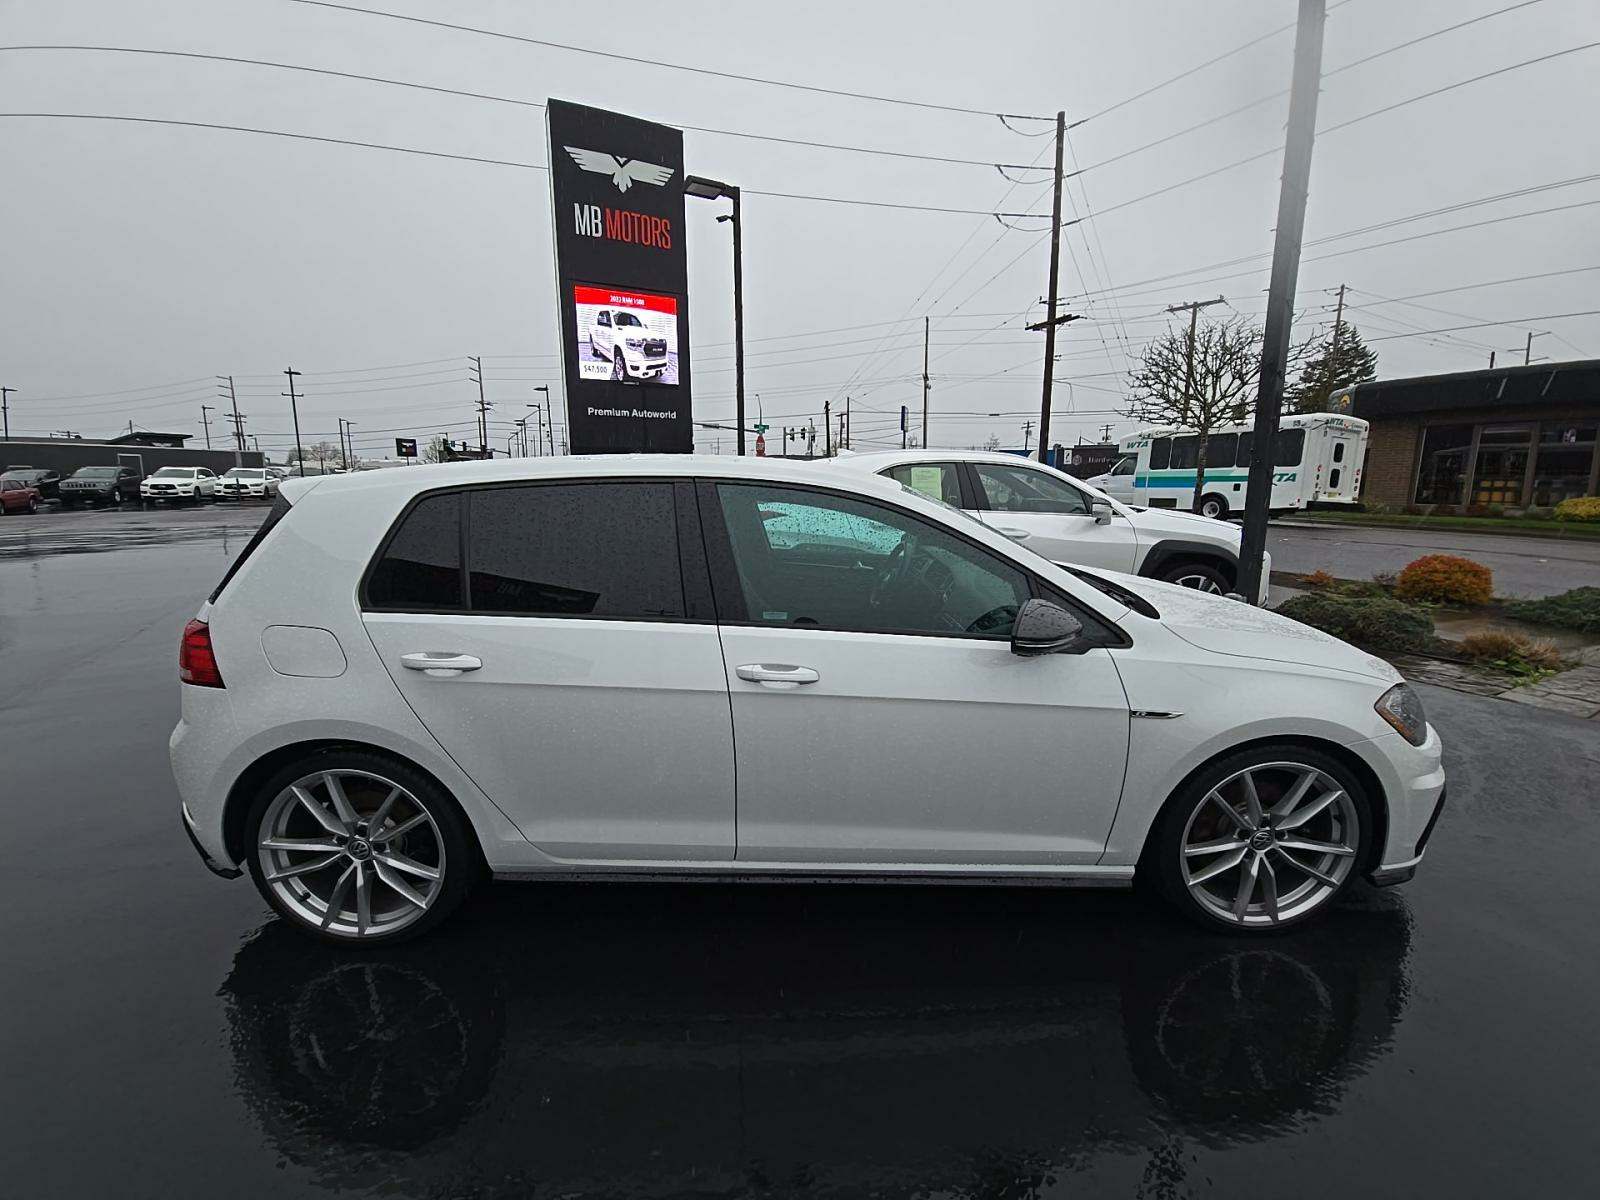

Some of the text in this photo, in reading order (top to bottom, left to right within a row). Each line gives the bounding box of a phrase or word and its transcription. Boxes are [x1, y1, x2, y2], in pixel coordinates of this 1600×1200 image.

[574, 202, 672, 250] MB MOTORS
[587, 407, 677, 419] Premium Autoworld
[1126, 440, 1149, 450] WTA
[1272, 472, 1297, 483] TA
